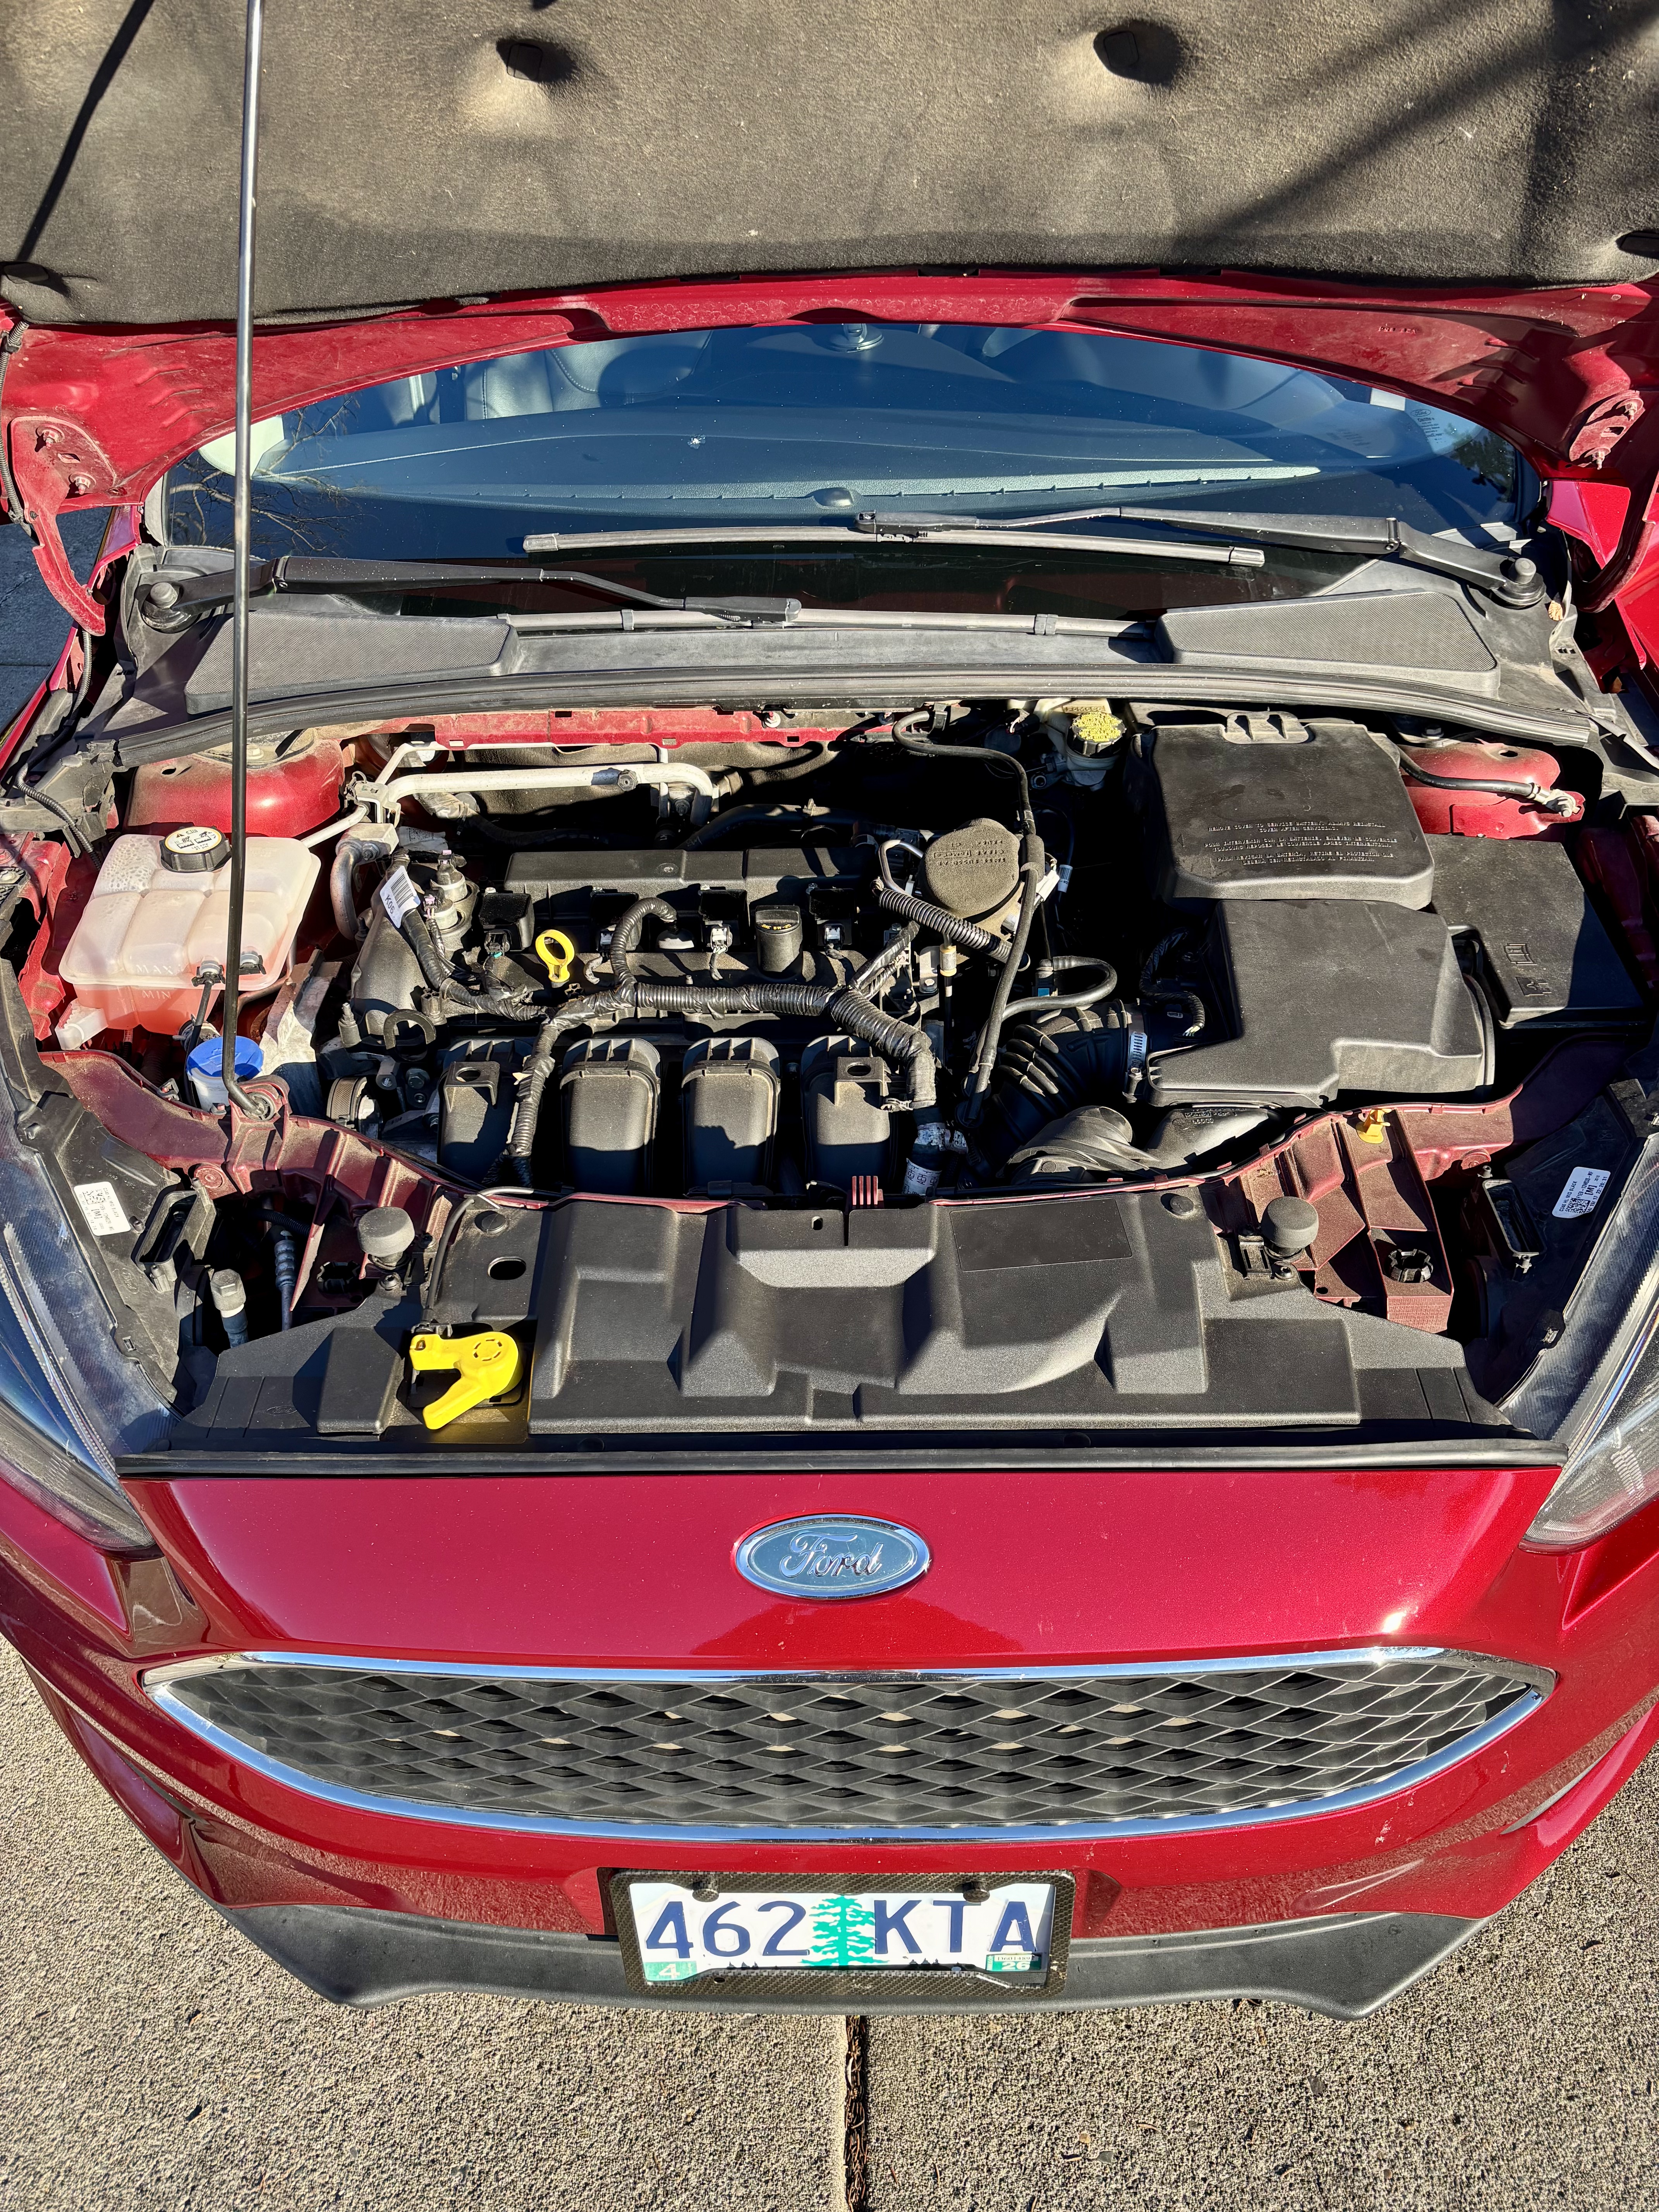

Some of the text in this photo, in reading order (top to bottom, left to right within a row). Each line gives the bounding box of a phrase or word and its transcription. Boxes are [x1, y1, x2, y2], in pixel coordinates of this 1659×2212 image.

[385, 895, 395, 914] K06
[136, 965, 173, 974] MAX
[142, 990, 171, 999] MIN
[780, 1532, 884, 1578] Ford
[646, 1899, 1037, 1959] 462 KTA
[659, 1963, 681, 1979] 4
[1001, 1961, 1030, 1971] 26
